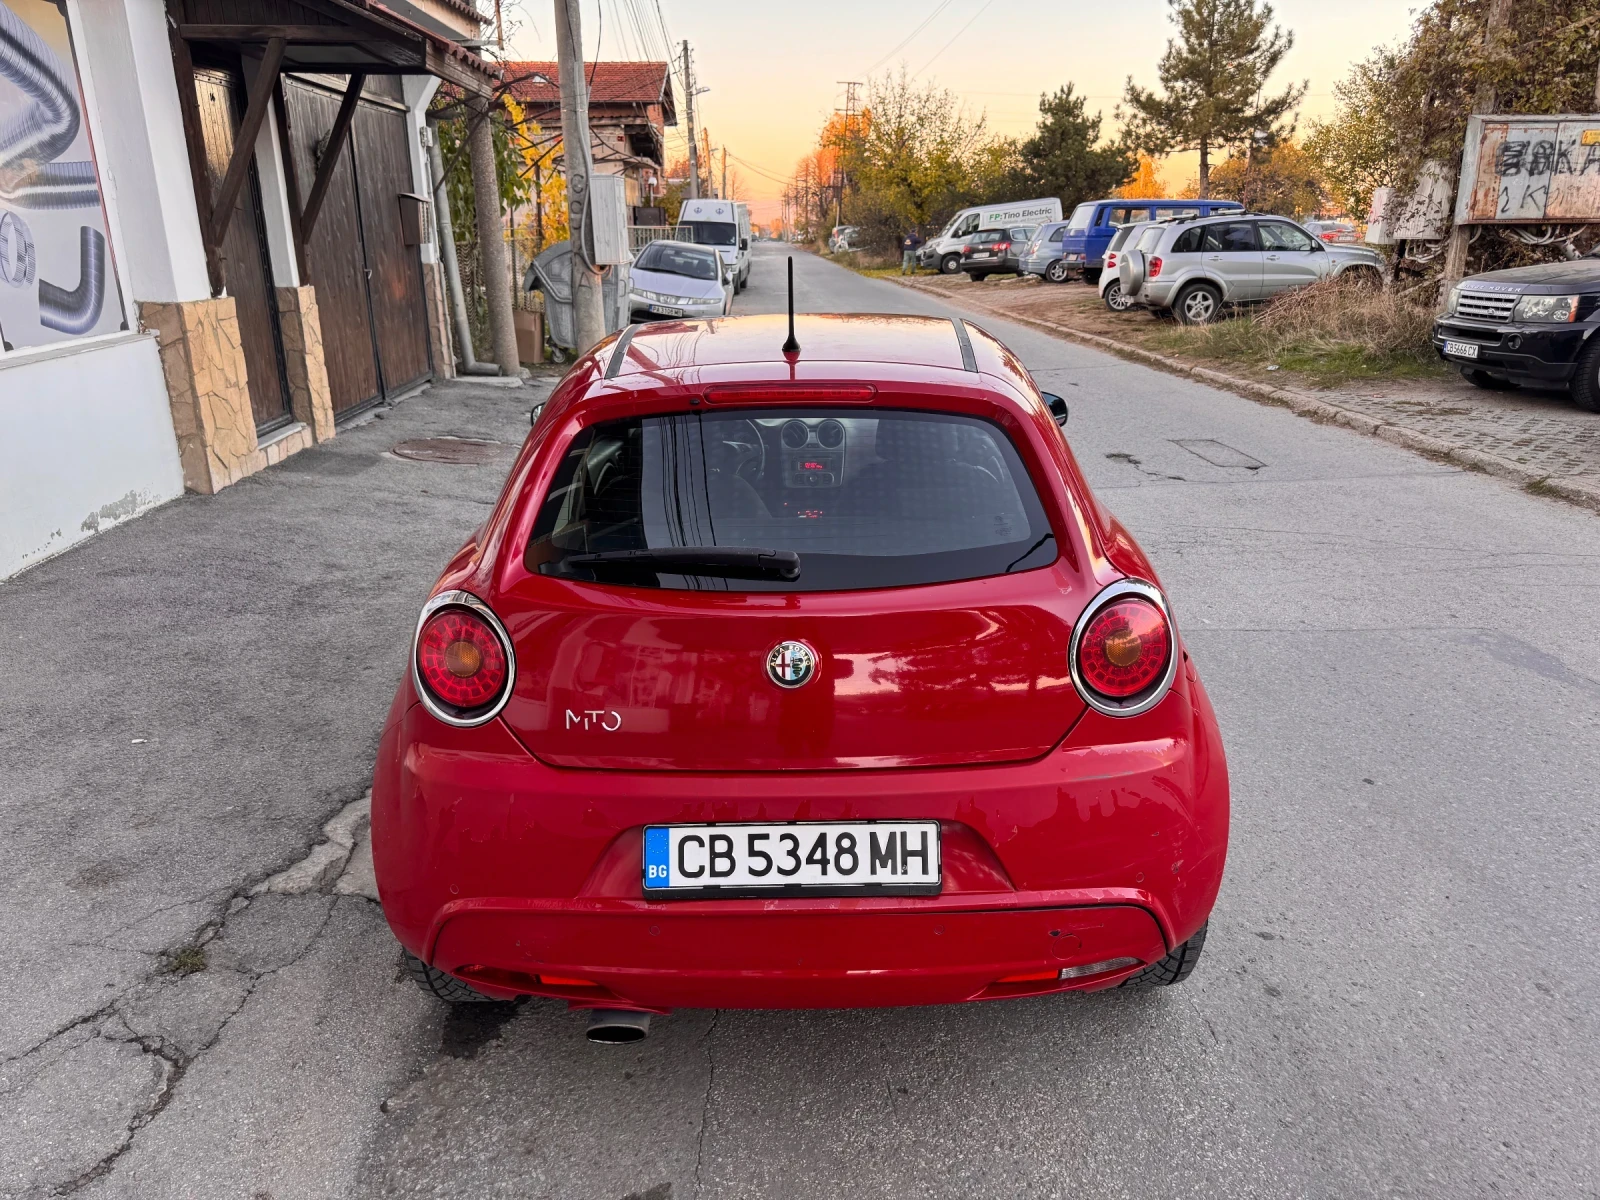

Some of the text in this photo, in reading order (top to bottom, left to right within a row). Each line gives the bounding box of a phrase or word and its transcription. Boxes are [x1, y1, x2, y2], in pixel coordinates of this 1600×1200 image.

[1022, 207, 1052, 217] Electric
[770, 645, 811, 666] ALFA ROMEO
[677, 830, 929, 878] CB 5348 MH
[648, 865, 667, 878] BG
